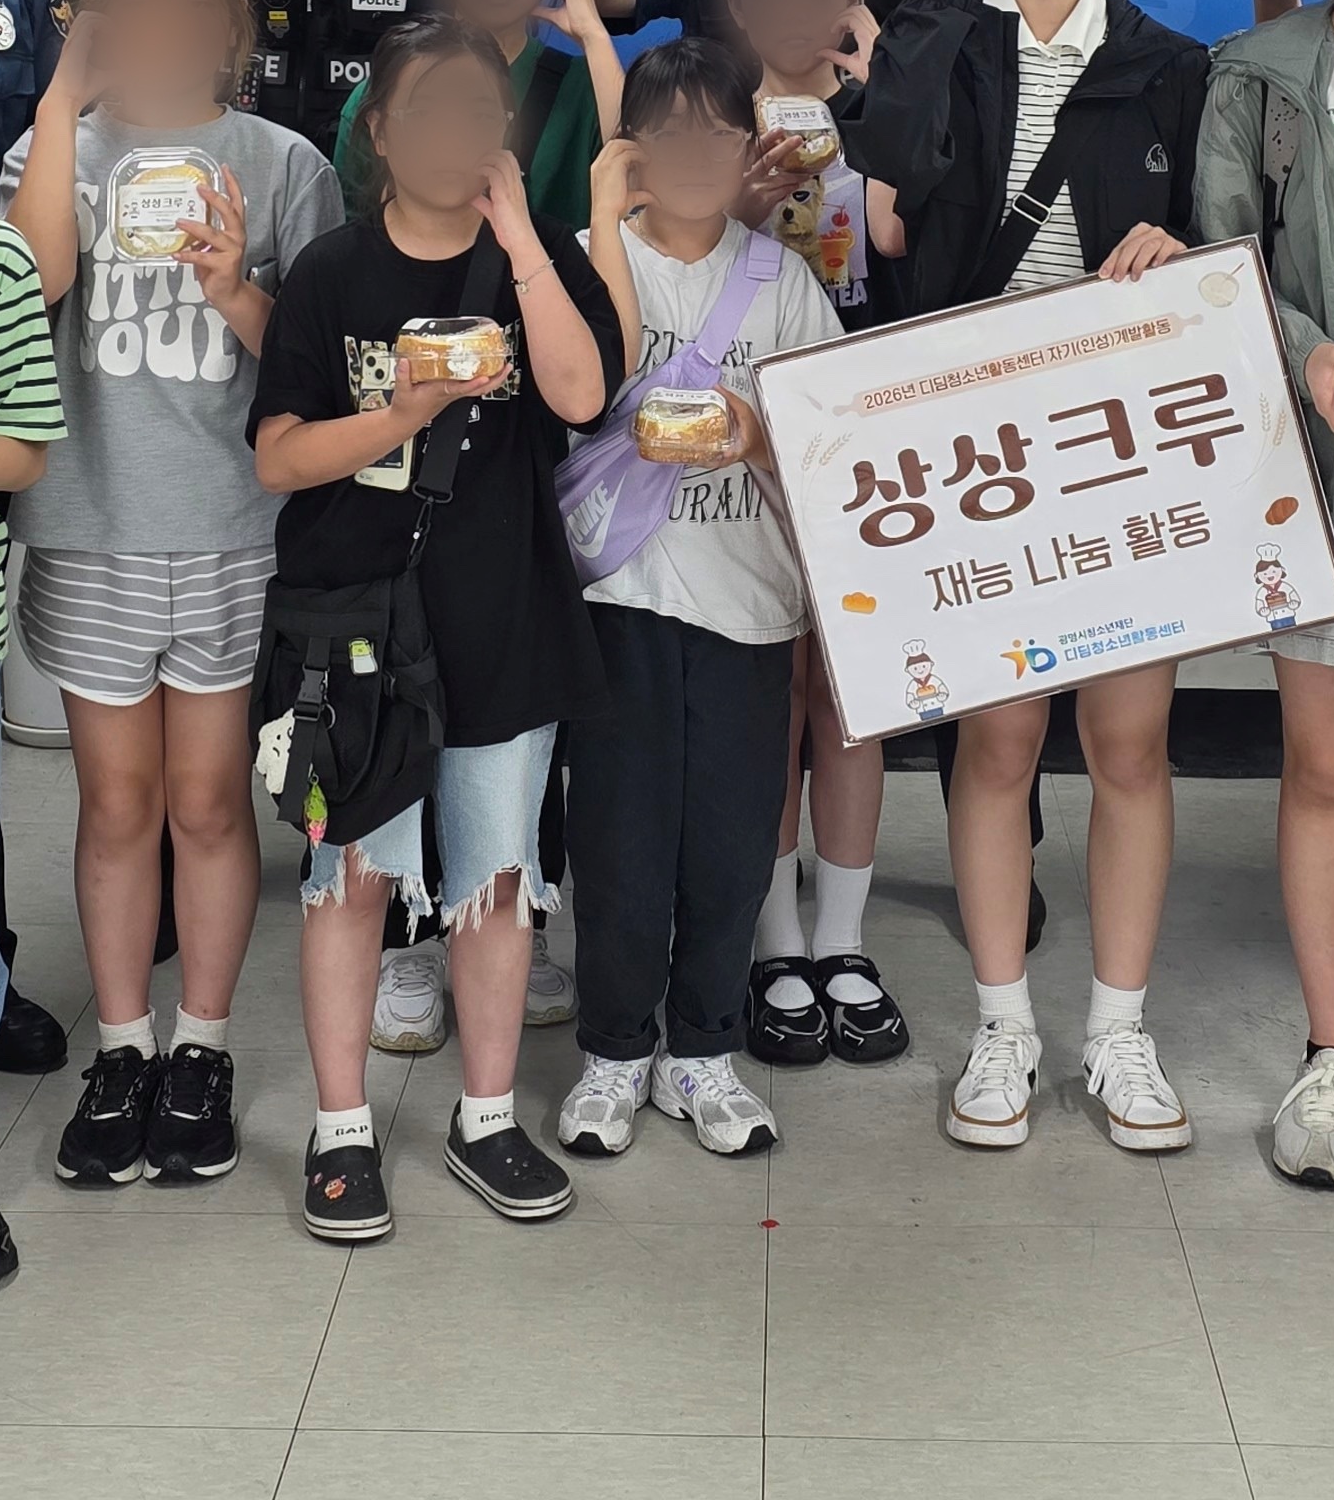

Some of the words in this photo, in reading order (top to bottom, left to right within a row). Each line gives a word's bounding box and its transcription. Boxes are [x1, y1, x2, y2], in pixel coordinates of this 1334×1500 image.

[864, 383, 917, 410] 2026년
[919, 350, 1046, 397] 디딤청소년활동센터
[842, 373, 1245, 548] 상상크루
[567, 479, 613, 543] NIKE
[925, 558, 1014, 612] 재능
[1023, 533, 1113, 586] 나눔
[1123, 501, 1211, 561] 활동
[1064, 620, 1186, 662] 디딤청소년활동센터
